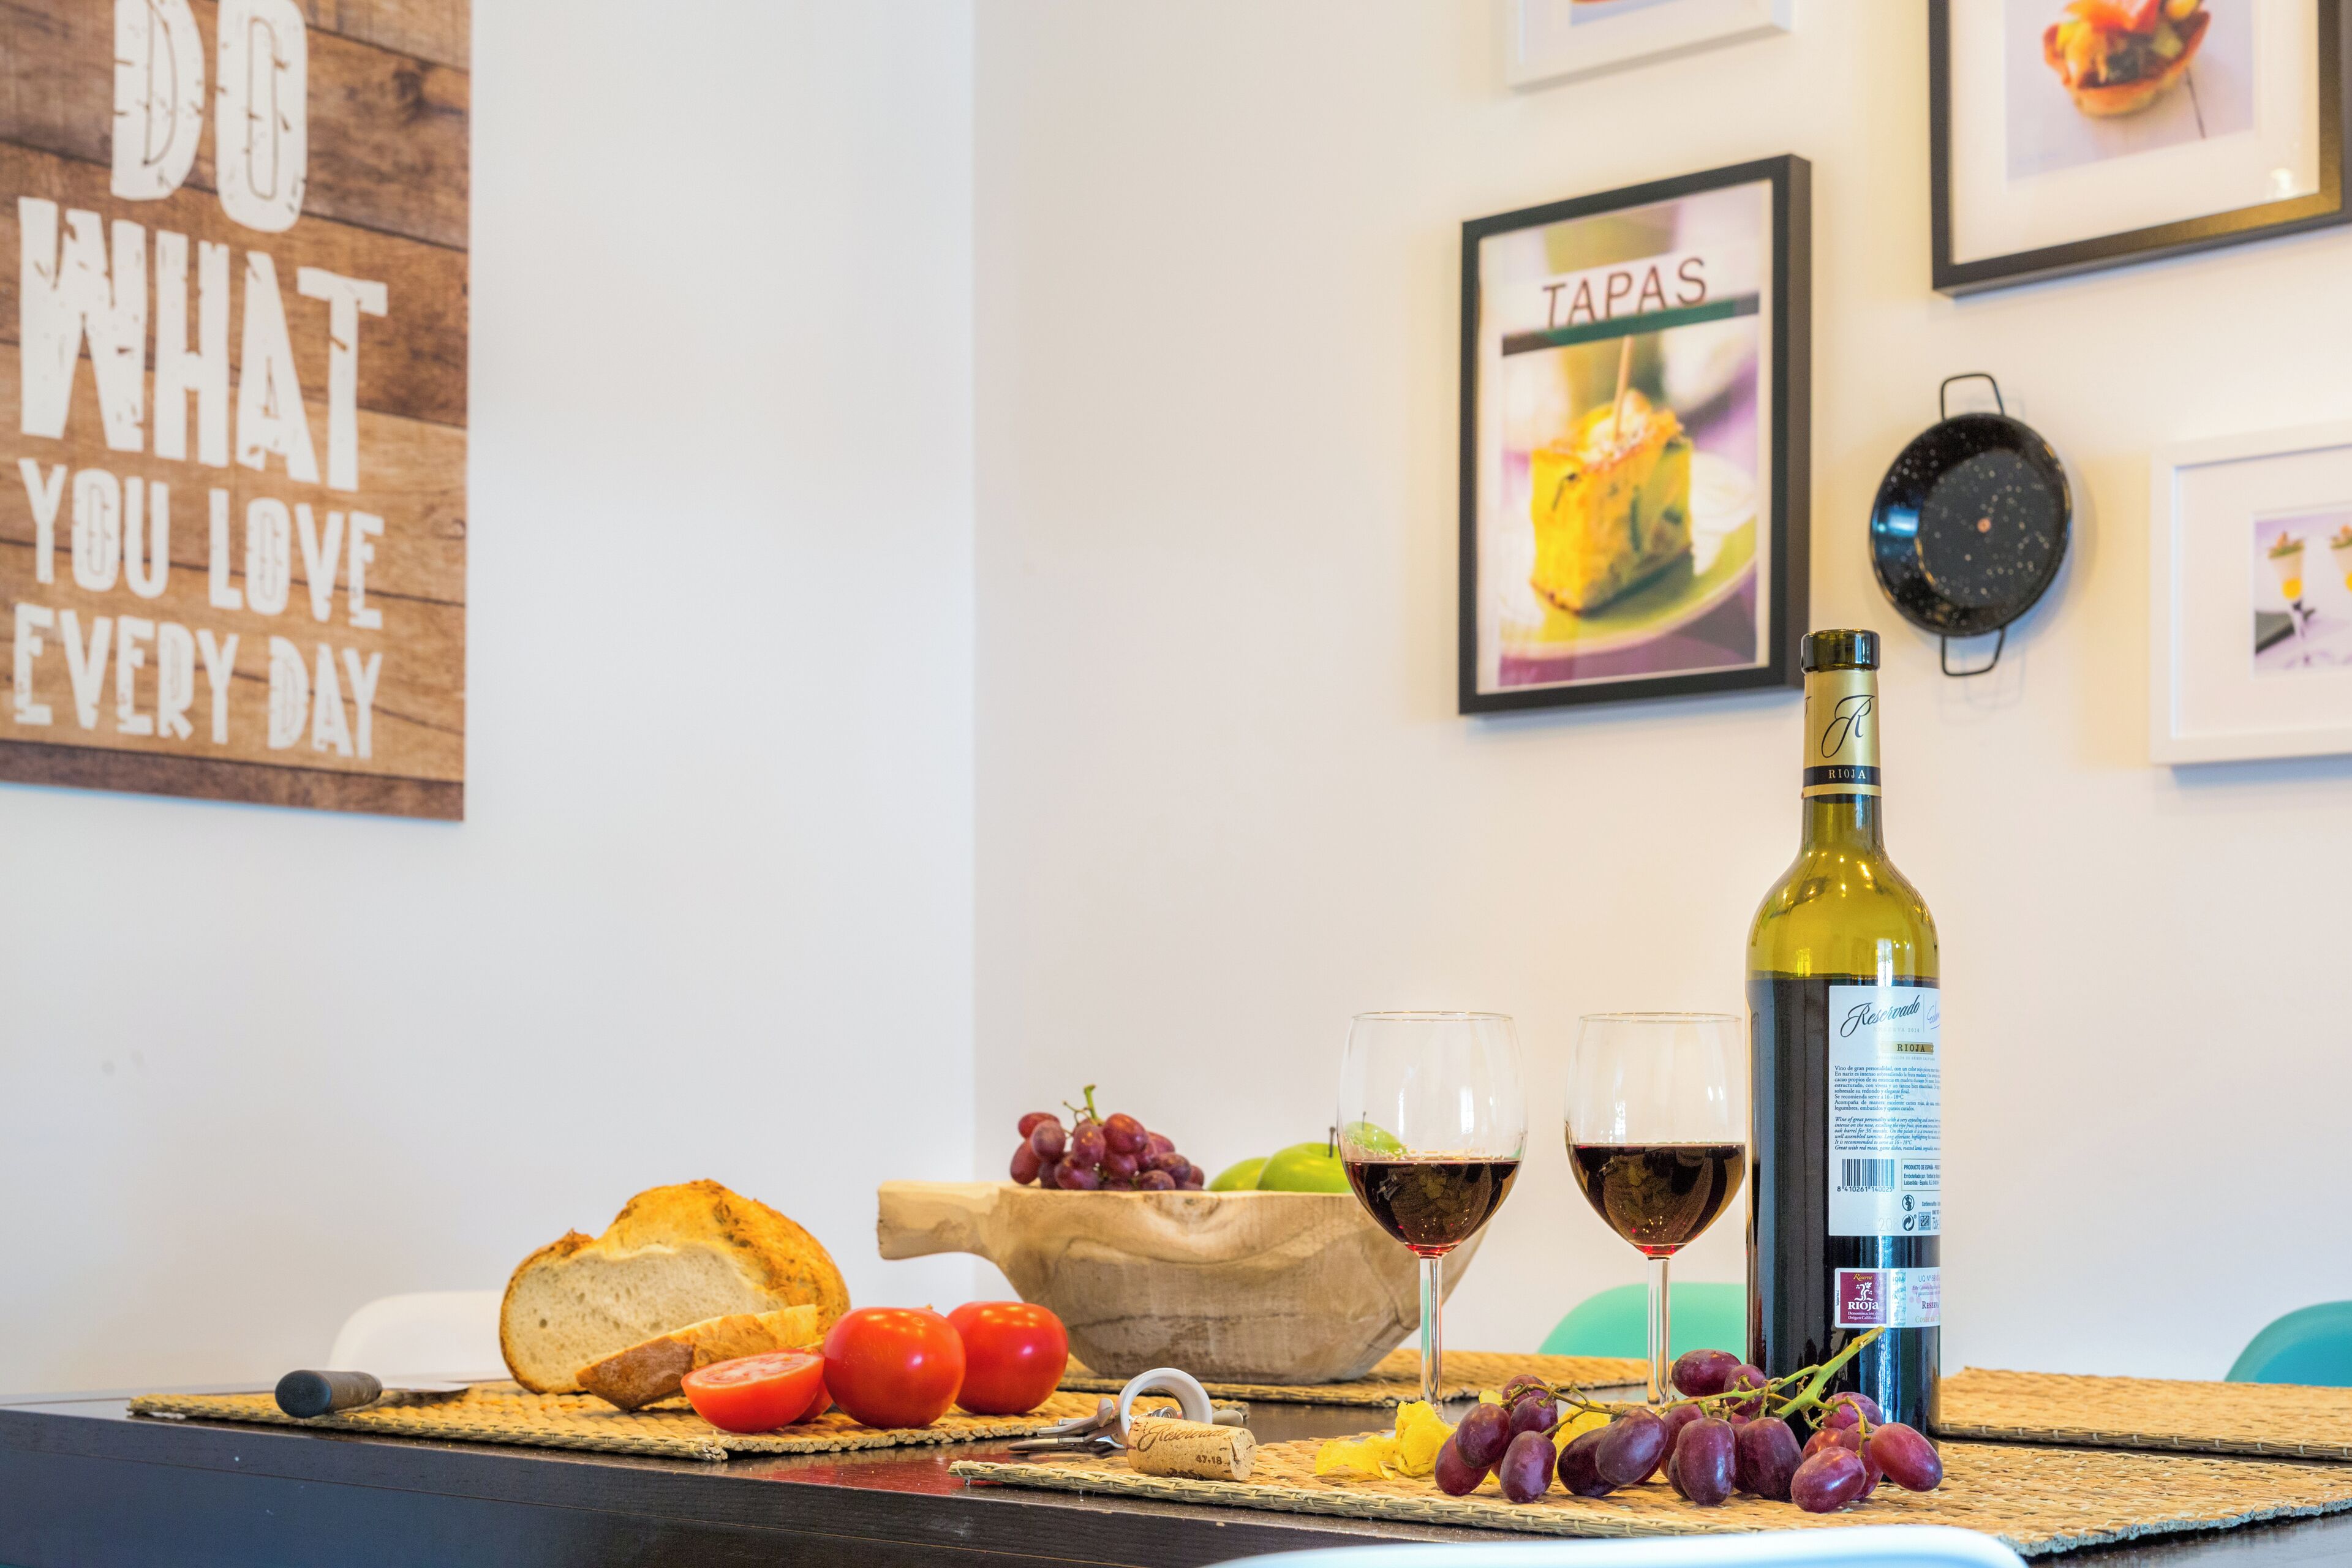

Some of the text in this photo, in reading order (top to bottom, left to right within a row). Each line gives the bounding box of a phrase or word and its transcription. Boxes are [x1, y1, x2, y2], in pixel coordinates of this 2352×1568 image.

[111, 0, 307, 233] DO
[18, 197, 389, 491] WHAT
[1542, 257, 1707, 331] TAPAS
[18, 458, 385, 630] YOU LOVE
[13, 603, 382, 759] EVERY DAY
[1829, 769, 1866, 778] RIOJA
[1840, 995, 1920, 1038] Reservado
[1137, 1423, 1230, 1452] Reservado
